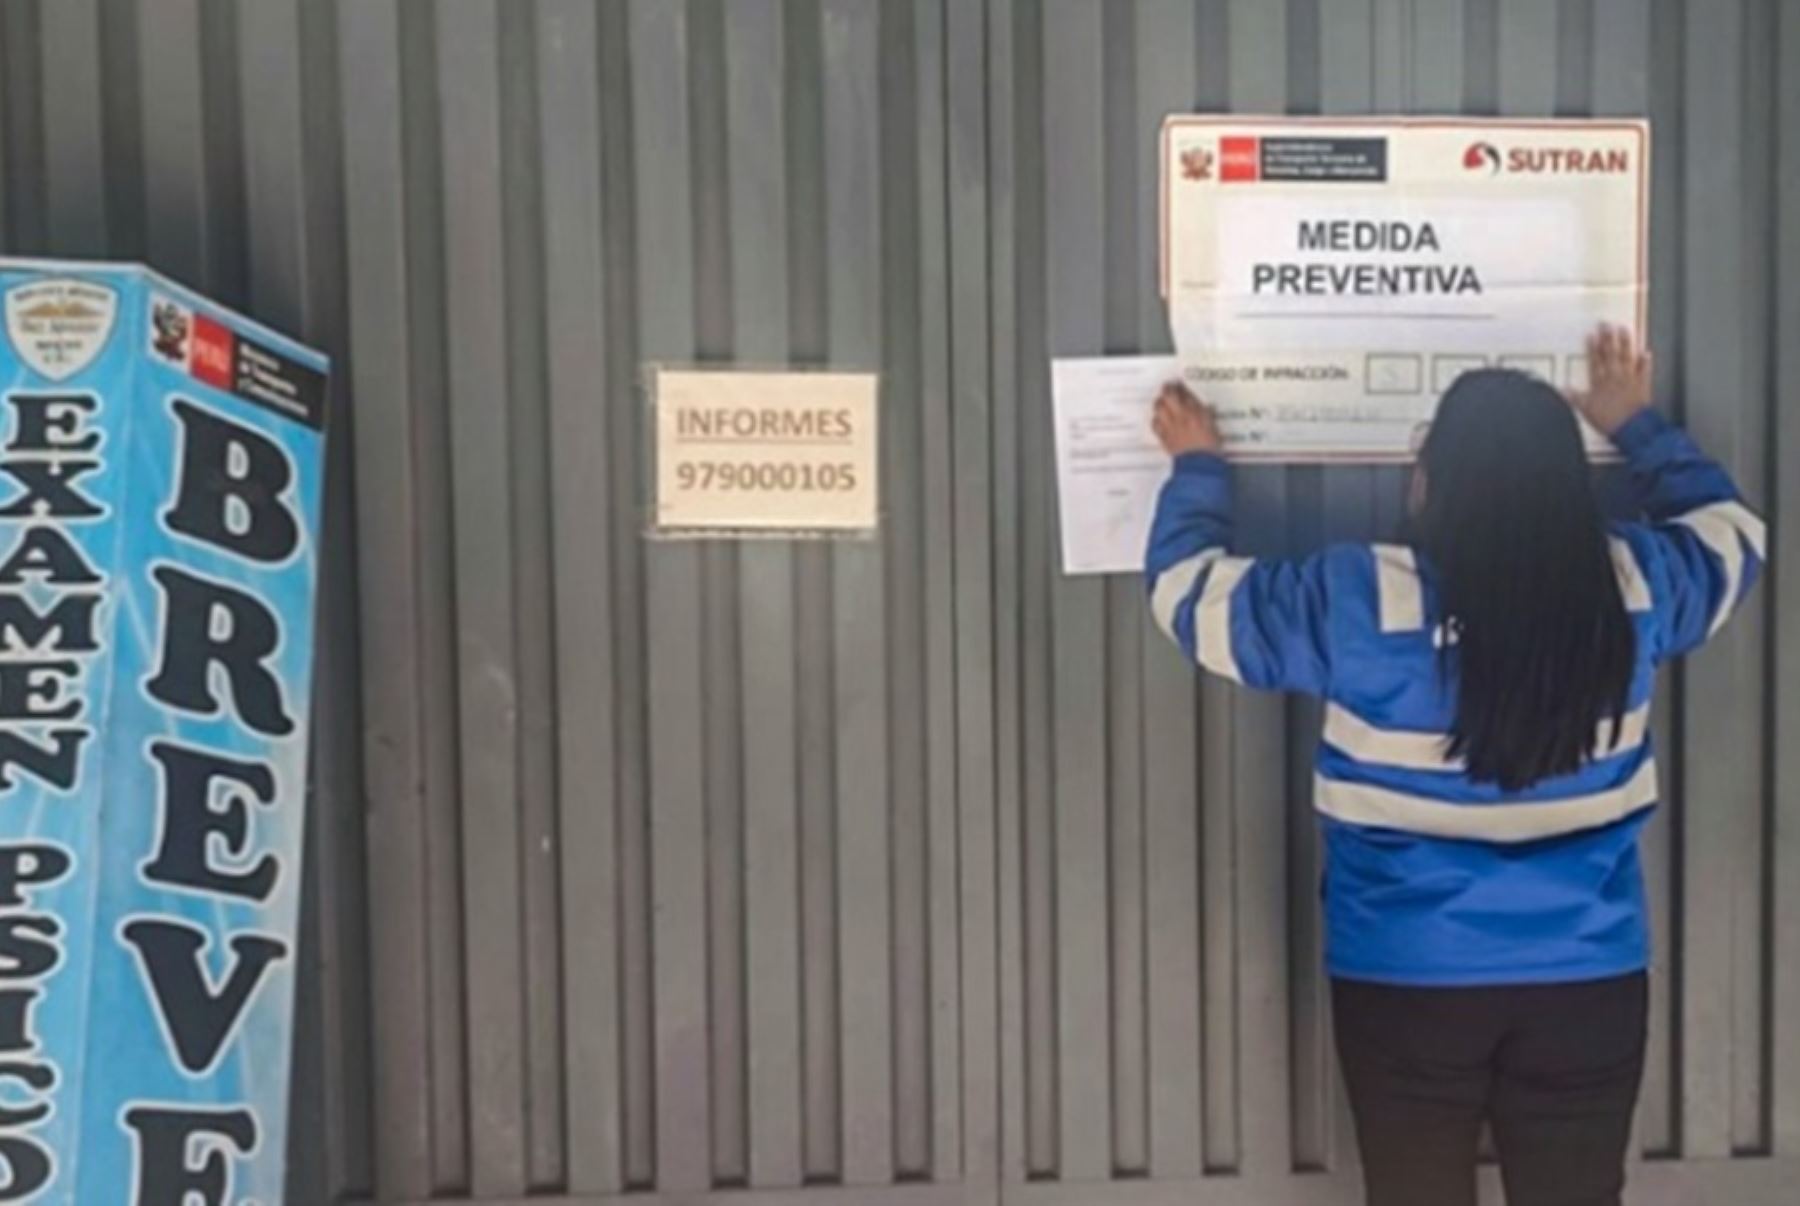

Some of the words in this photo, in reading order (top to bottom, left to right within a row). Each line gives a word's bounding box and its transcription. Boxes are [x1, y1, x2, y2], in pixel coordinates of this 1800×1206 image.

[1507, 148, 1628, 174] SUTRAN
[1297, 220, 1440, 253] MEDIDA
[1252, 263, 1483, 295] PREVENTIVA
[676, 408, 853, 437] INFORMES
[676, 461, 858, 491] 979000105
[0, 394, 106, 792] EXAMEN
